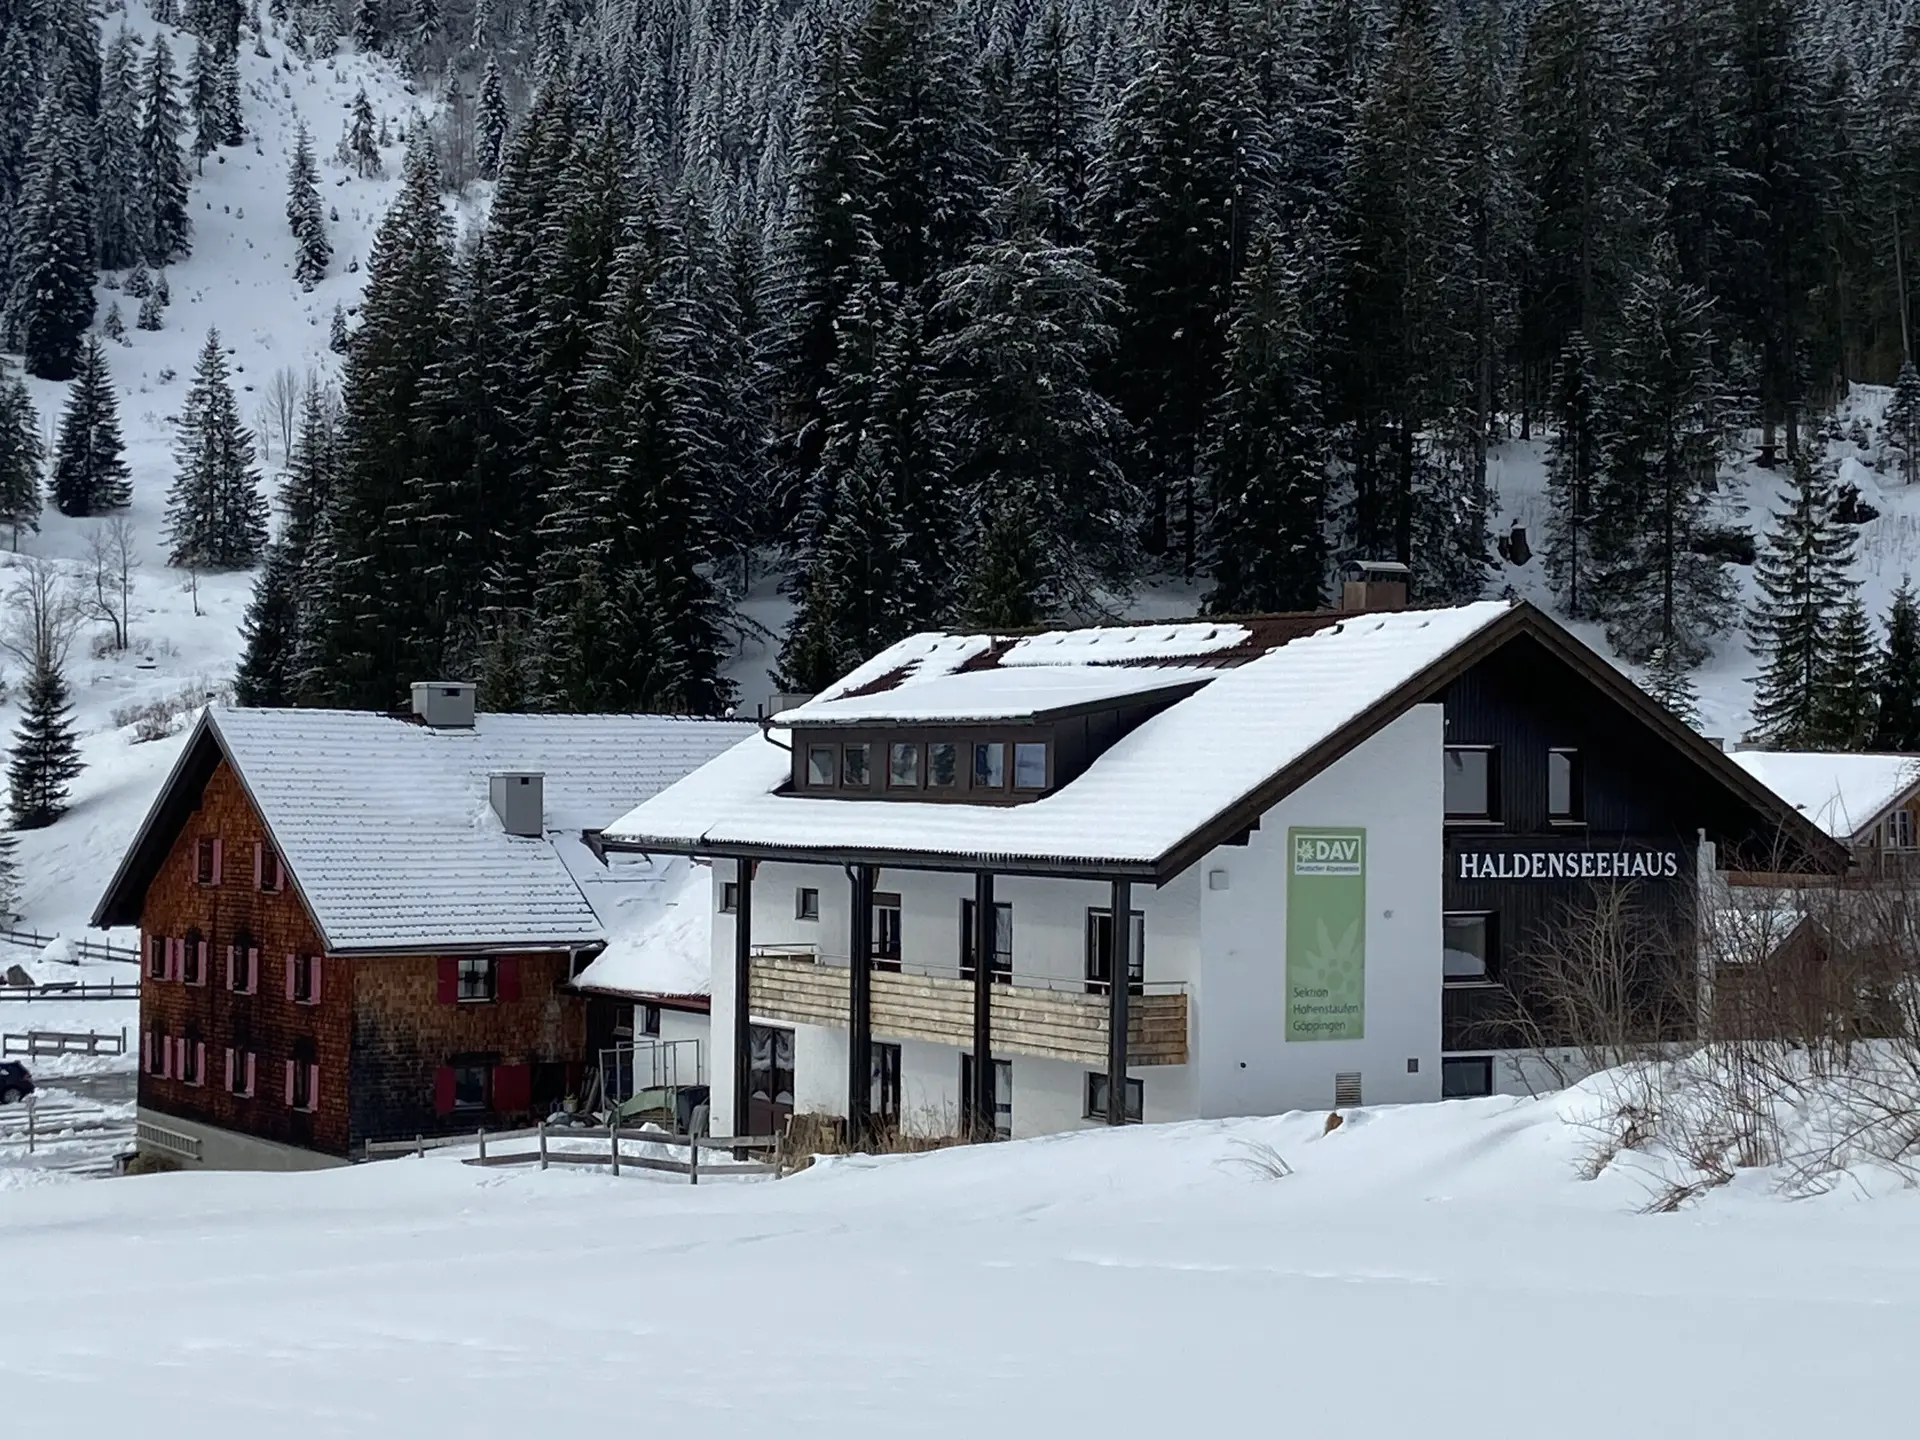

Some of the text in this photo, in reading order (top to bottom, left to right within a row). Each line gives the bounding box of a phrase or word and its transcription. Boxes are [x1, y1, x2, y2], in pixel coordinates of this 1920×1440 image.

[1316, 841, 1357, 860] DAV
[1460, 852, 1677, 878] HALDENSEEHAUS
[1293, 987, 1329, 998] Sektion
[1292, 1003, 1359, 1015] Hohenstaufen
[1292, 1020, 1346, 1034] Göppingen
